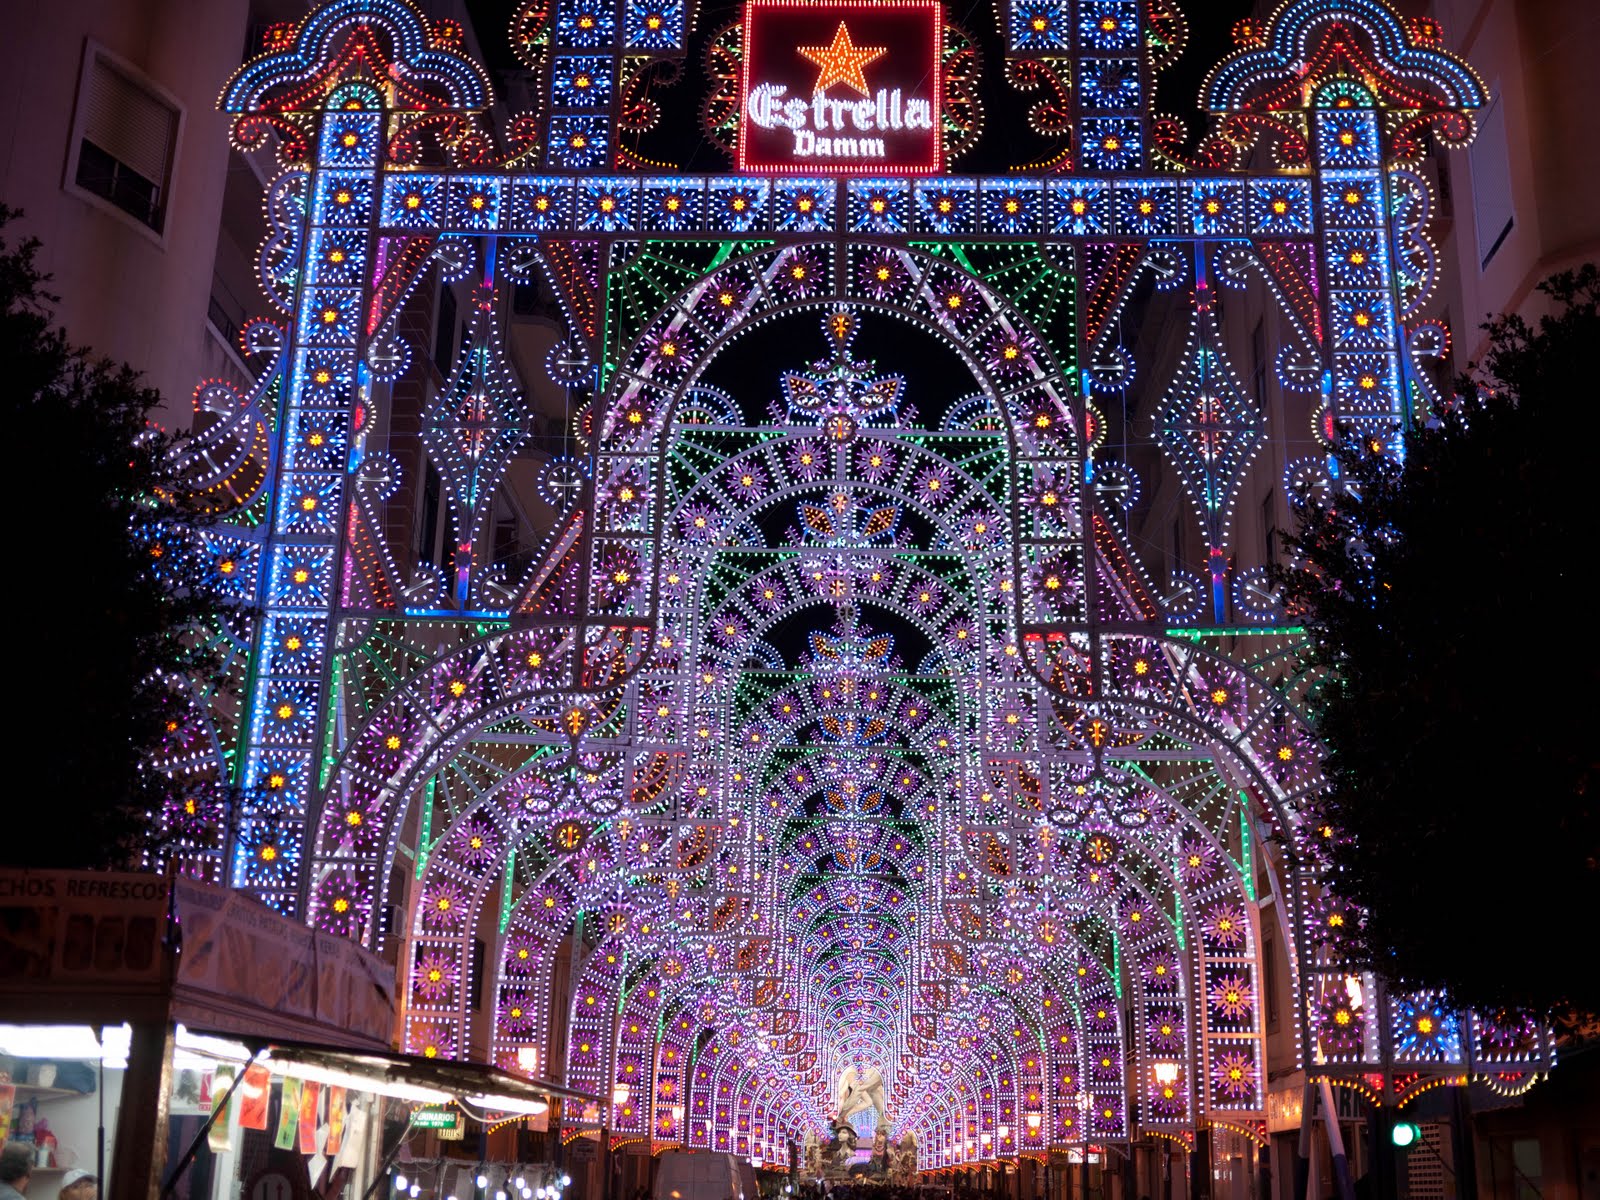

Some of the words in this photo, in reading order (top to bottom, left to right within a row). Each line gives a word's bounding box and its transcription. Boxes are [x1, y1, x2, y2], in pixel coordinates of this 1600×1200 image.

[749, 82, 933, 130] Estrella
[793, 129, 885, 157] Damm
[66, 879, 168, 901] REFRESCOS
